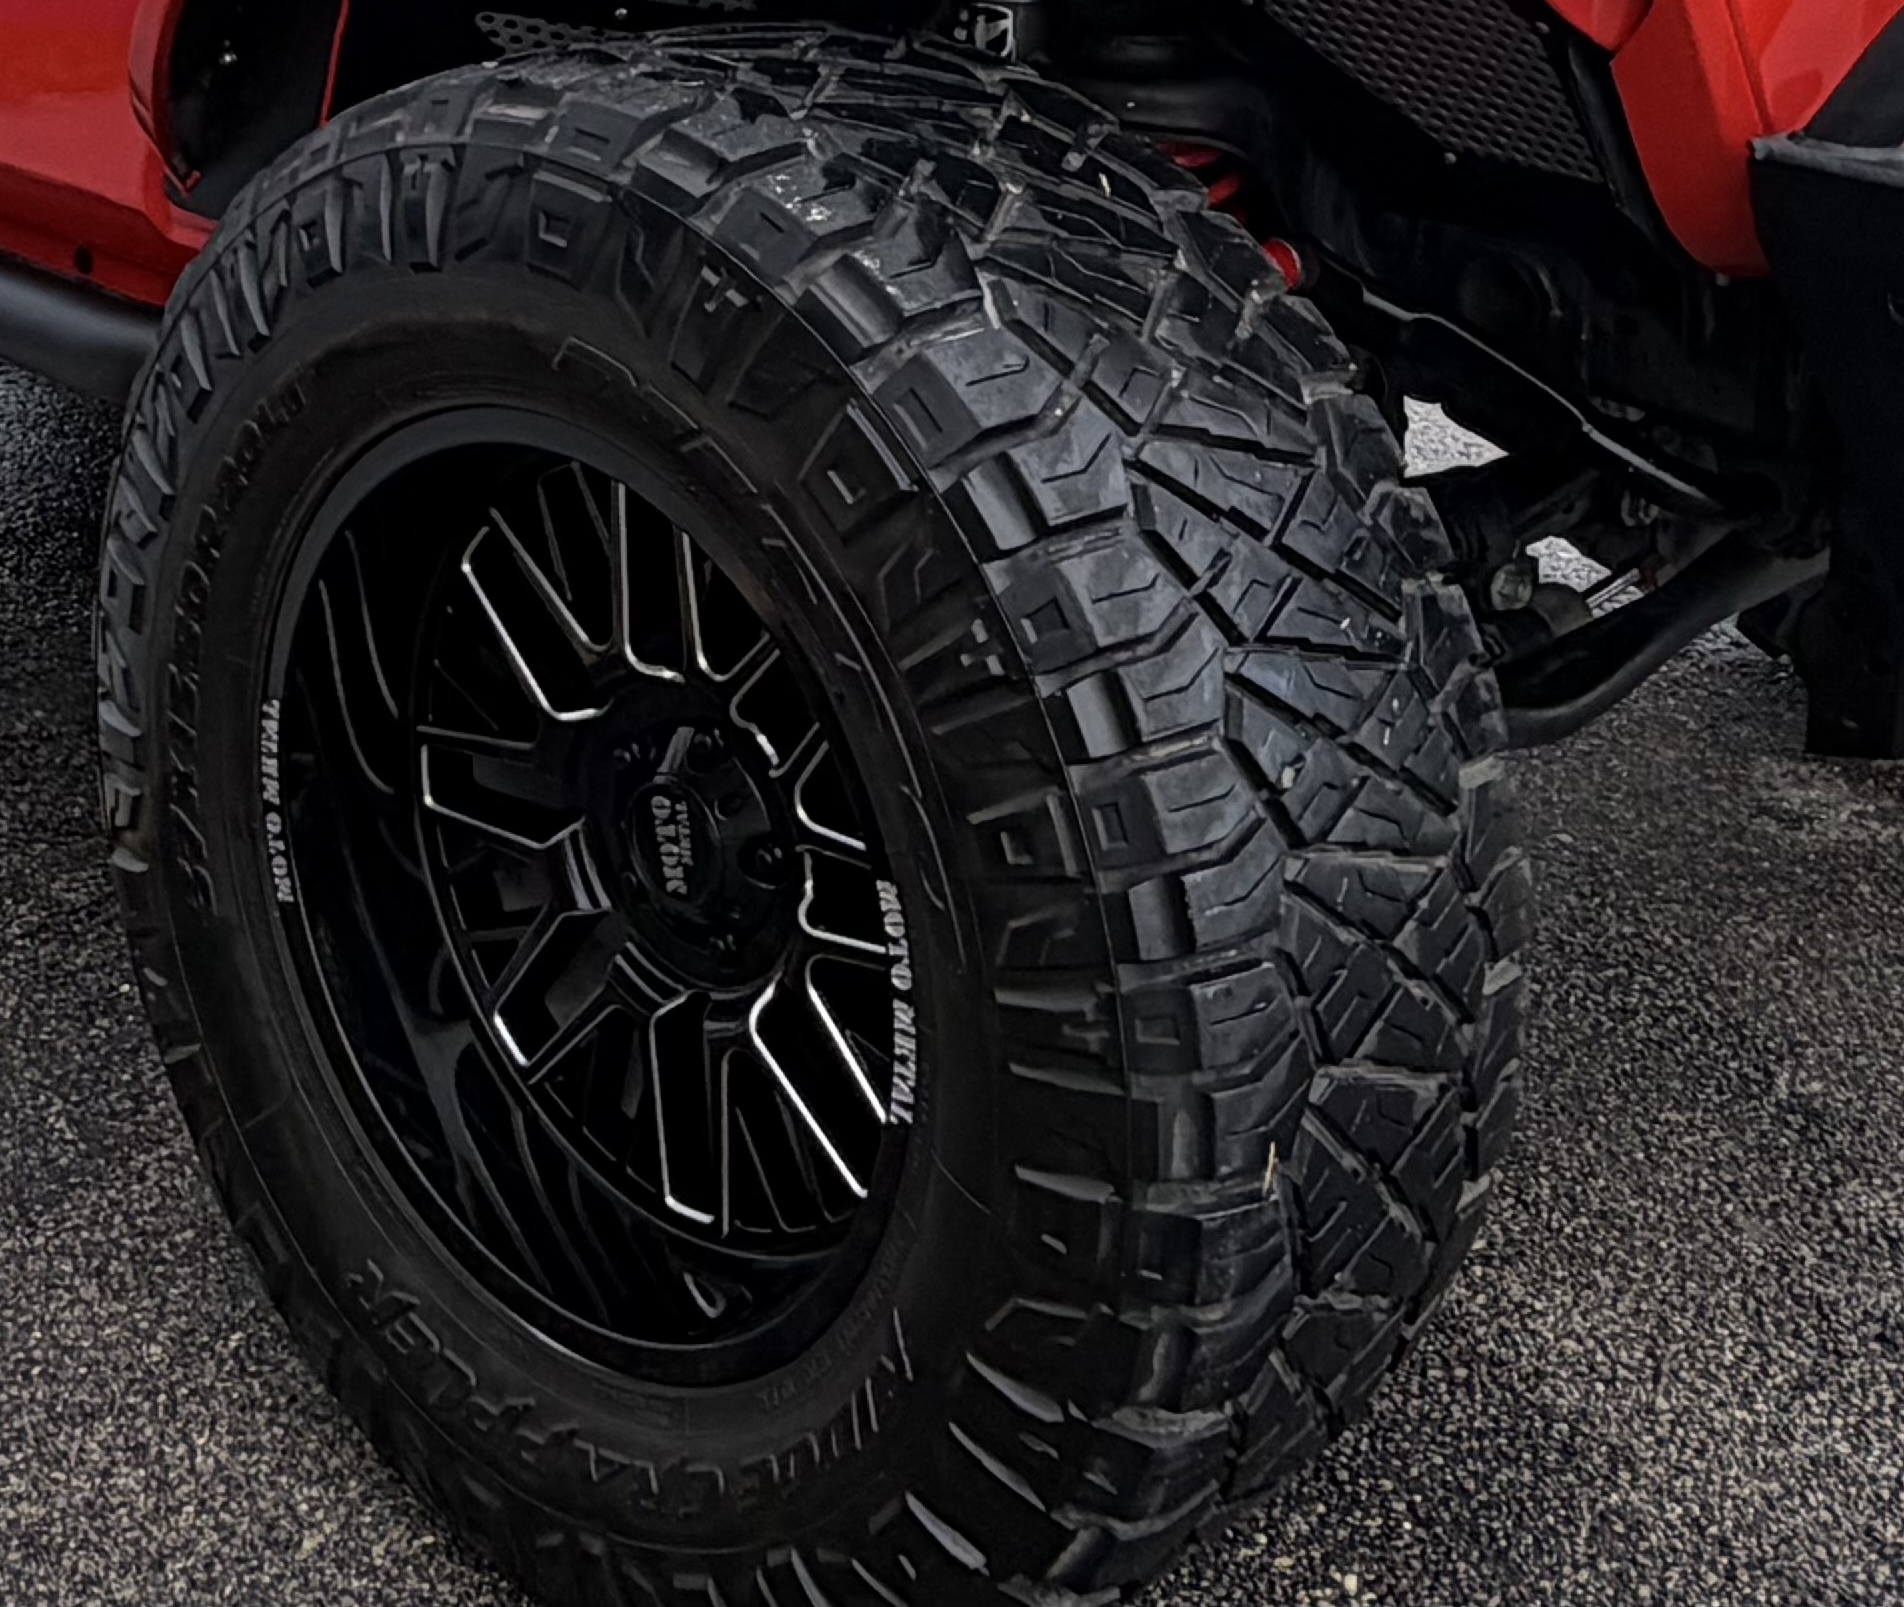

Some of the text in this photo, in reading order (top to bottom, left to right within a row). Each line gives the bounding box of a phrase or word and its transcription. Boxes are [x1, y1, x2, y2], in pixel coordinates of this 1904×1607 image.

[260, 698, 295, 903] MOTO METAL
[651, 795, 688, 894] MOTO
[875, 879, 918, 1126] MOTO METAL
